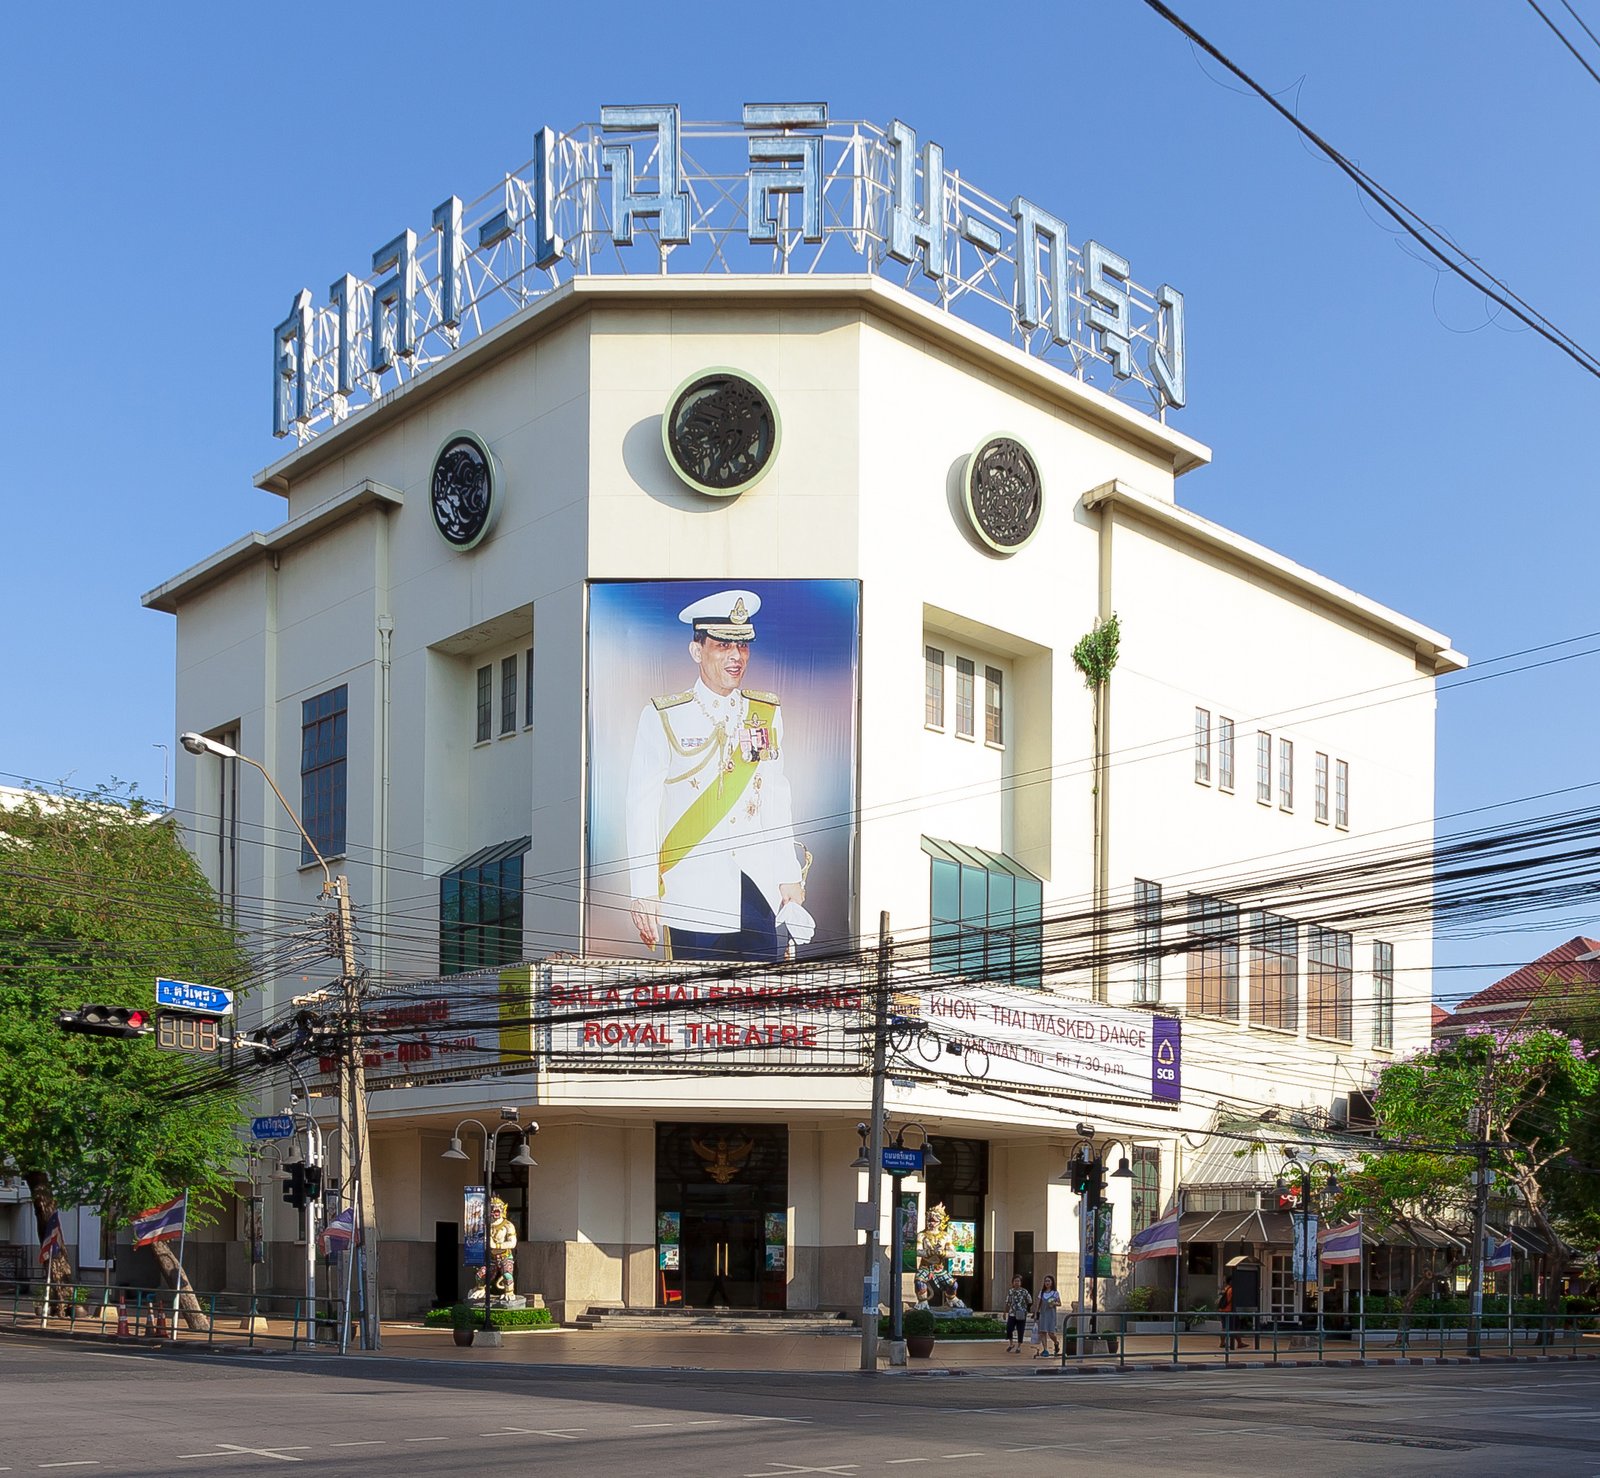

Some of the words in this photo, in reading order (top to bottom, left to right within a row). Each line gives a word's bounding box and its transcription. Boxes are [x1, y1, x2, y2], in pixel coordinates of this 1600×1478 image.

[549, 985, 621, 1006] SALA
[930, 994, 977, 1021] KHON
[991, 1005, 1027, 1030] THAI
[1032, 1012, 1095, 1041] MASKED
[1099, 1024, 1146, 1049] DANCE
[584, 1022, 673, 1044] ROYAL
[687, 1023, 817, 1046] THEATRE
[1024, 1047, 1044, 1064] Thu
[1055, 1051, 1070, 1067] Fri
[1075, 1055, 1100, 1073] 7.30
[1156, 1068, 1175, 1081] SCB
